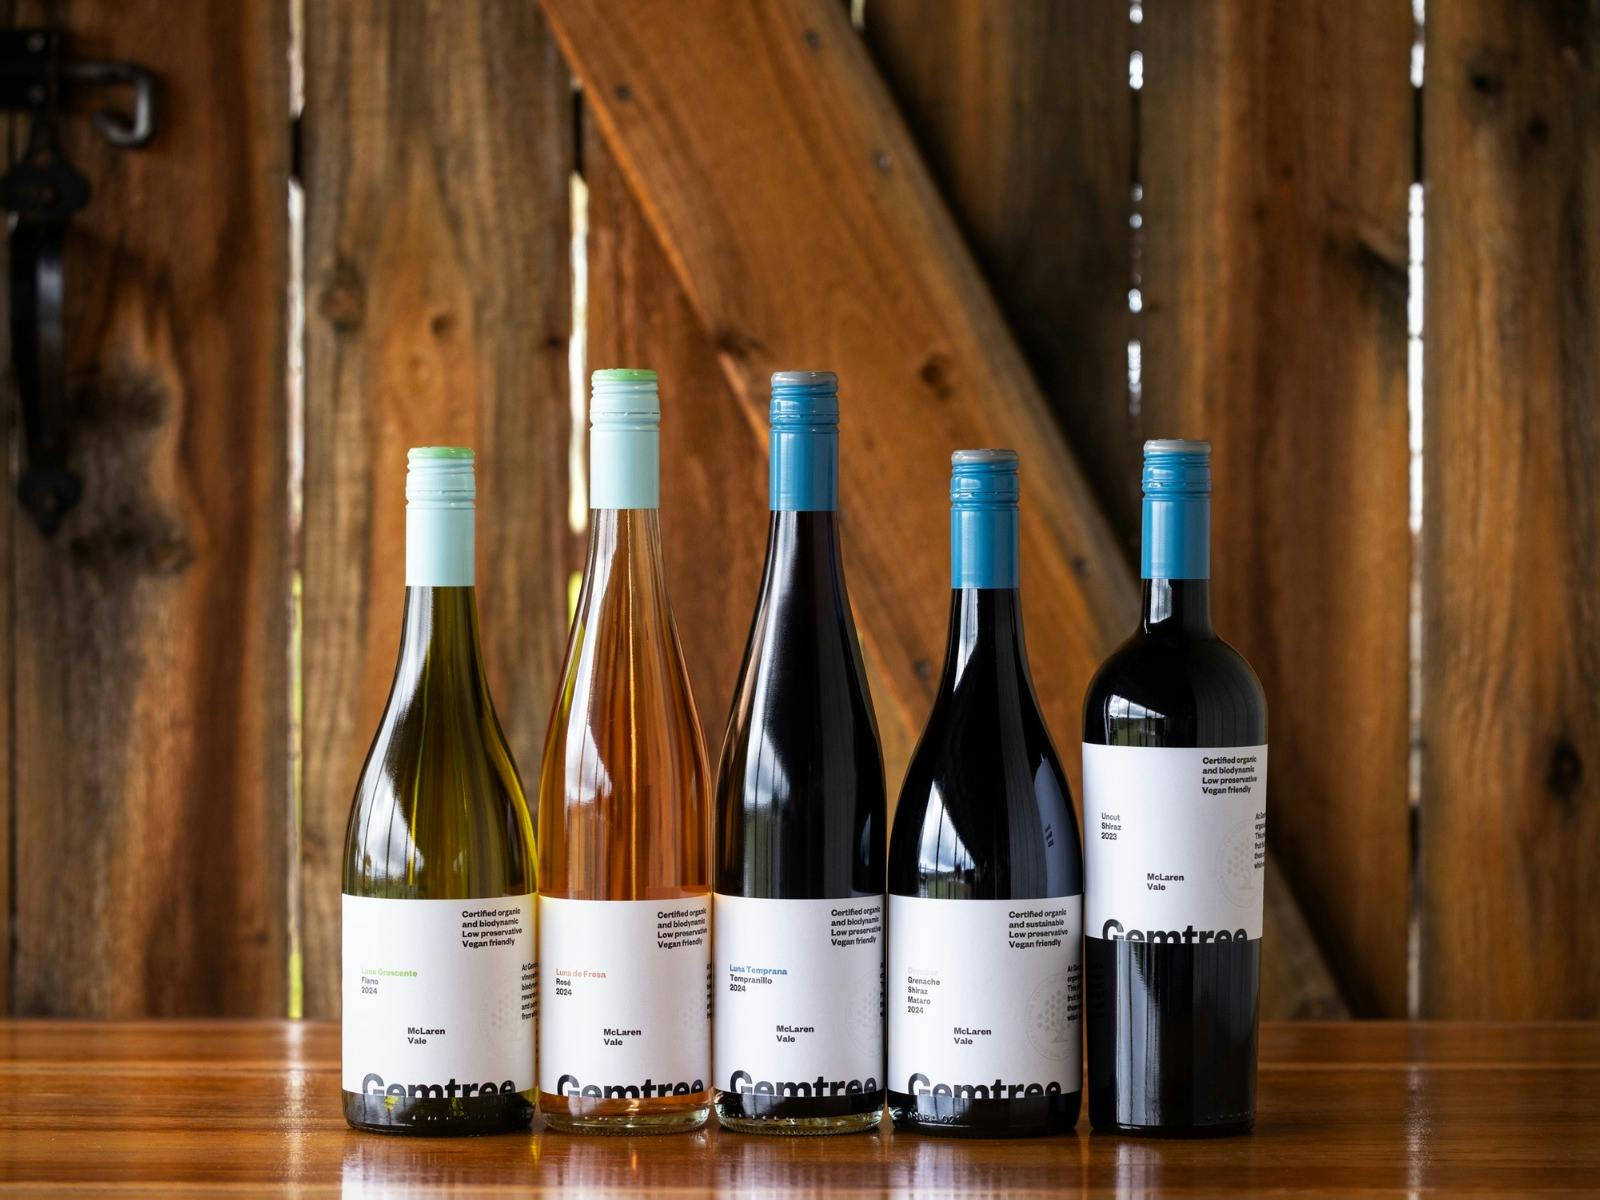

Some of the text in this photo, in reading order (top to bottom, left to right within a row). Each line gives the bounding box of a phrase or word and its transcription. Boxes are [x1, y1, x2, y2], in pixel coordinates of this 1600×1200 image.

[1202, 756, 1257, 765] Certified organic
[1202, 777, 1219, 785] Low
[1202, 785, 1251, 795] Vegan friendly
[1101, 812, 1120, 821] Uncut
[1101, 822, 1121, 831] Shiraz
[1101, 832, 1118, 840] 2023
[1147, 873, 1184, 881] McLaren
[1147, 883, 1166, 891] Vale
[462, 907, 521, 918] Certified organic
[657, 908, 706, 919] Certified organic
[831, 906, 881, 917] Certified organic
[1009, 908, 1067, 918] Certified organic
[462, 918, 519, 929] and biodynamic
[657, 921, 672, 929] and
[831, 918, 846, 926] and
[1026, 918, 1064, 928] sustainable
[462, 927, 523, 939] Low preservative
[657, 931, 674, 939] Low
[831, 929, 847, 937] Low
[1027, 928, 1068, 939] preservative
[1103, 919, 1247, 944] Gemtree
[462, 938, 515, 949] Vegan friendly
[657, 937, 703, 949] Vegan friendly
[831, 936, 877, 947] Vegan friendly
[1009, 938, 1061, 949] Vegan friendly
[377, 968, 418, 977] Crescente
[746, 966, 788, 976] Temprana
[730, 974, 773, 985] Tempranillo
[907, 977, 941, 986] Grenache
[361, 986, 377, 995] 2024
[556, 988, 572, 996] 2024
[729, 984, 746, 992] 2024
[907, 986, 928, 995] Shiraz
[907, 996, 931, 1005] Mataro
[907, 1006, 924, 1014] 2024
[407, 1027, 446, 1035] McLaren
[603, 1028, 642, 1036] McLaren
[776, 1025, 814, 1033] McLaren
[954, 1027, 992, 1035] McLaren
[407, 1037, 427, 1045] Vale
[603, 1038, 623, 1046] Vale
[776, 1035, 795, 1043] Vale
[954, 1037, 973, 1045] Vale
[362, 1073, 516, 1098] Gemtree
[557, 1074, 703, 1099] Gemtree
[730, 1070, 876, 1097] Gemtree
[908, 1072, 1061, 1099] Gemtree
